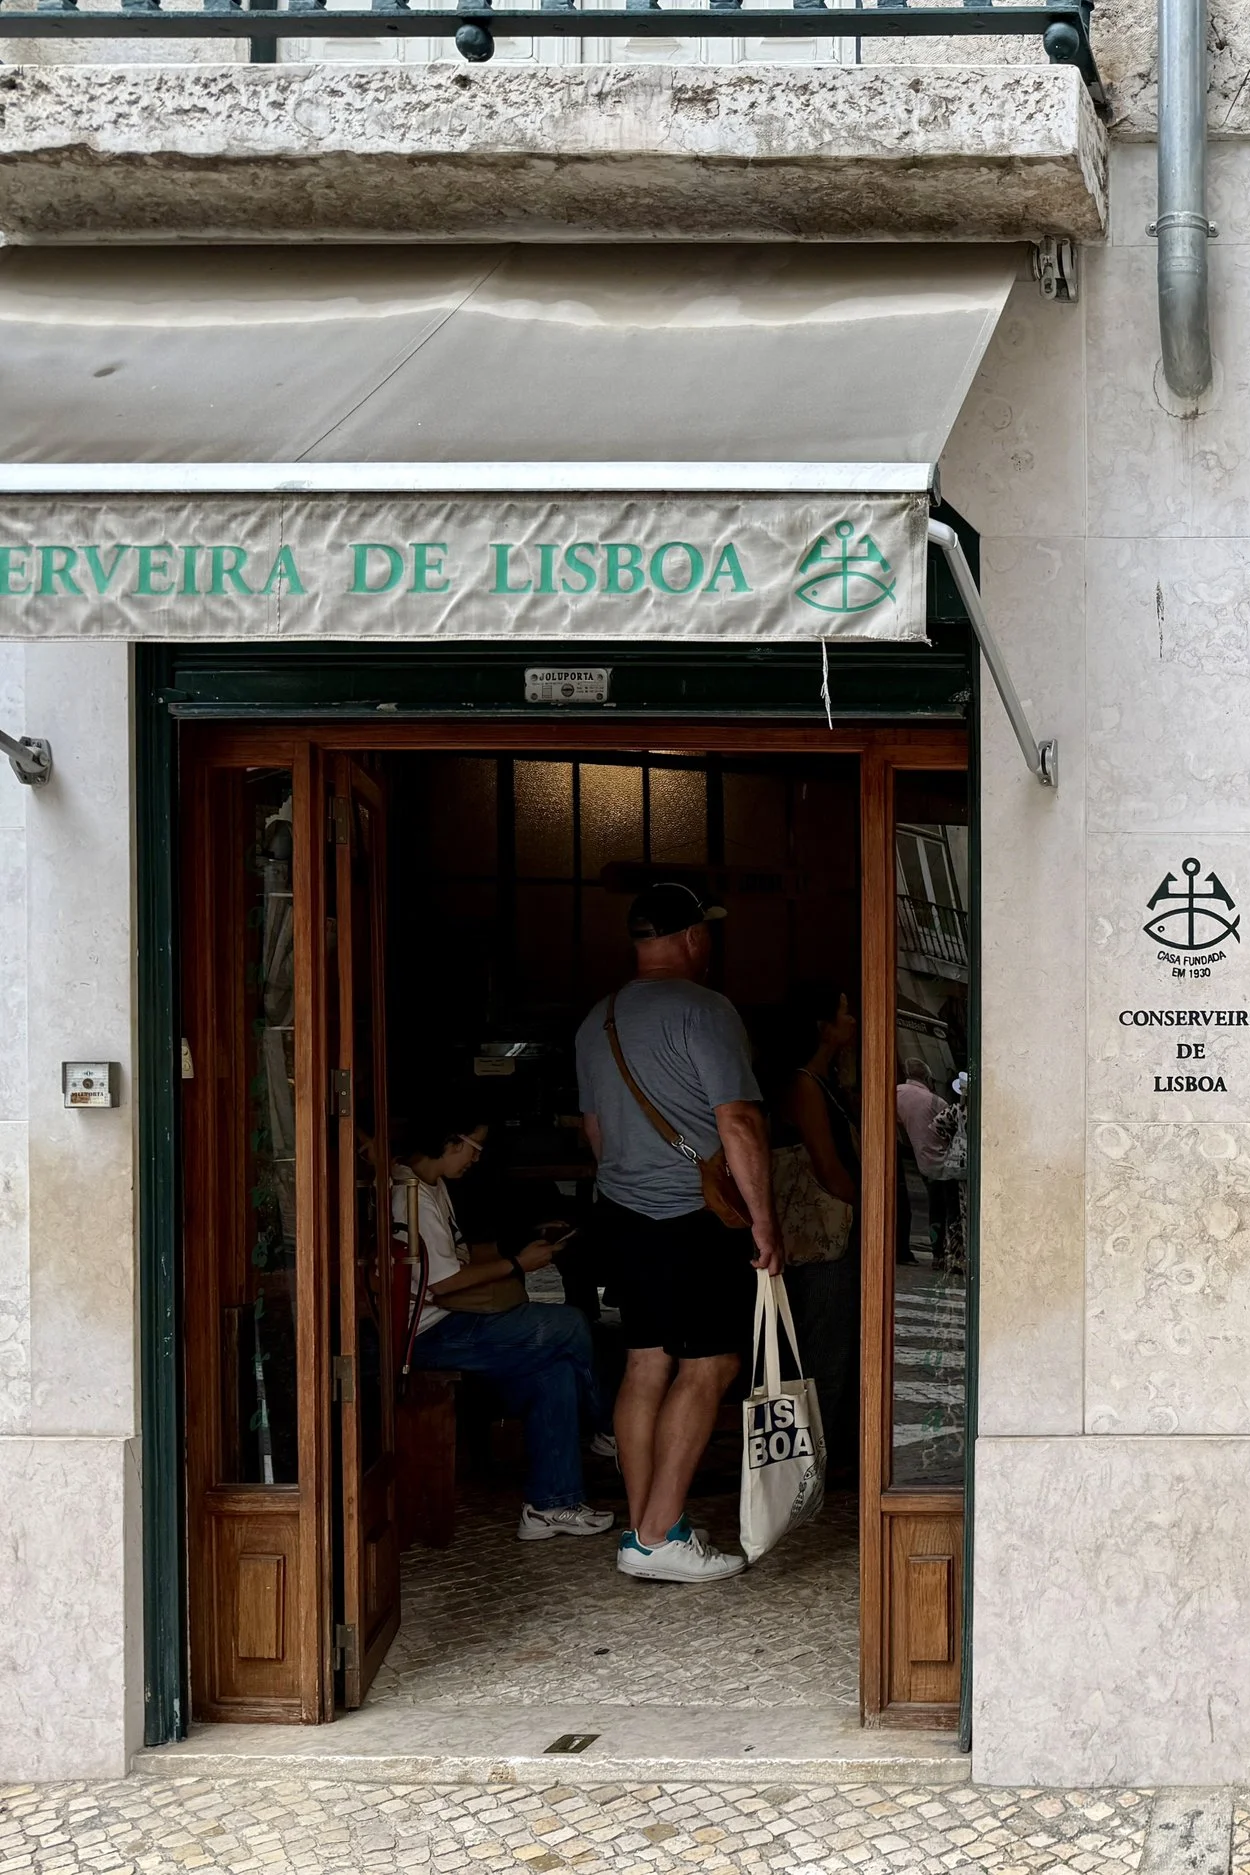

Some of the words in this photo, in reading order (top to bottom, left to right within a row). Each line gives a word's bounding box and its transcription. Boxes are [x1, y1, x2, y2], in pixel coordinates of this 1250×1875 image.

[0, 544, 310, 596] ERVEIRA
[347, 541, 450, 595] DE
[490, 541, 754, 595] LISBOA
[540, 672, 594, 681] JOLUPORTA
[1157, 950, 1181, 965] CASA
[1183, 950, 1227, 966] FUNDADA
[1171, 967, 1186, 978] EM
[1189, 967, 1211, 979] 1930
[1176, 1043, 1206, 1059] DE
[1153, 1075, 1228, 1093] LISBOA
[748, 1399, 795, 1438] LIS
[749, 1428, 815, 1469] BOA
